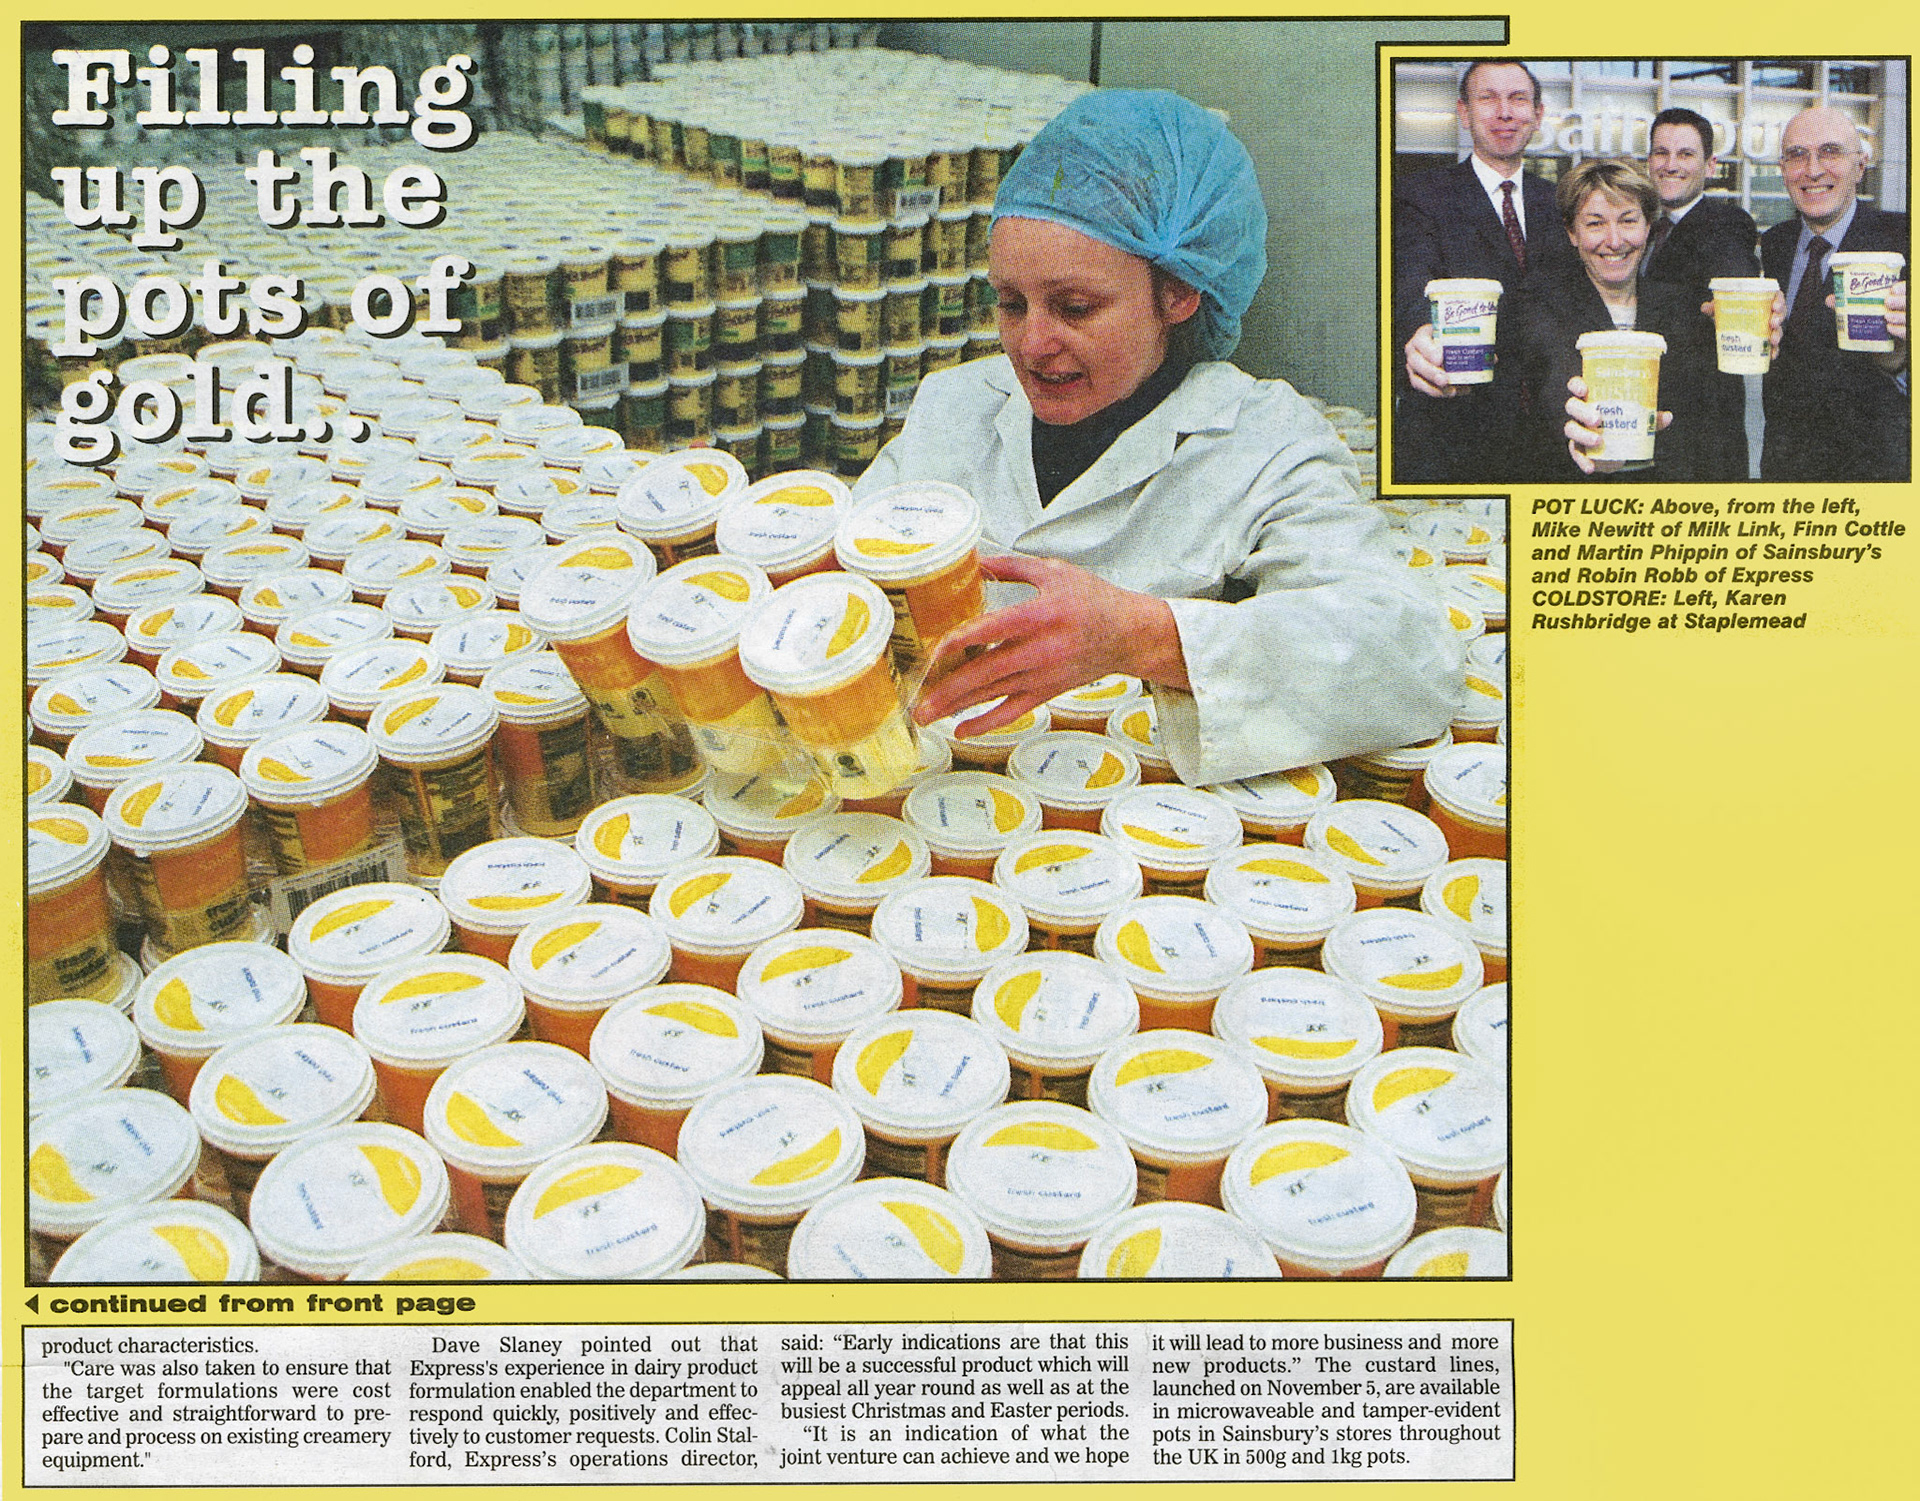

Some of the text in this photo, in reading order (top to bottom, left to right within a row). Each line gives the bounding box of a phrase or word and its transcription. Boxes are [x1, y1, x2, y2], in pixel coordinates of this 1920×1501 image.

[51, 44, 475, 150] Filling
[51, 147, 445, 249] up the
[52, 257, 307, 358] pots
[351, 254, 475, 337] of
[52, 362, 371, 464] gold..
[1597, 418, 1638, 430] ustard
[1532, 498, 1859, 517] POT LUCK: Above, from the left,
[1532, 521, 1905, 539] Mike Newitt of Milk Link, Finn Cottle
[1532, 544, 1881, 564] and Martin Phippin of Sainsbury’s
[1532, 567, 1813, 586] and Robin Robb of Express
[1533, 590, 1786, 609] COLDSTORE: Left, Karen
[1532, 613, 1807, 633] Rushbridge at Staplemead
[50, 1294, 475, 1315] continued from front page
[42, 1337, 258, 1358] product characteristics.
[433, 1336, 758, 1356] Dave Slaney pointed out that
[782, 1334, 822, 1350] said:
[902, 1334, 1000, 1349] indications
[1010, 1338, 1039, 1349] are
[1050, 1333, 1086, 1349] that
[1096, 1333, 1128, 1349] this
[1153, 1334, 1498, 1350] it will lead to more business and more
[121, 1364, 155, 1376] was
[163, 1360, 198, 1376] also
[206, 1360, 255, 1375] taken
[263, 1361, 279, 1375] to
[286, 1363, 348, 1375] ensure
[356, 1359, 391, 1375] that
[505, 1359, 604, 1379] experience
[612, 1359, 628, 1375] in
[635, 1359, 681, 1378] dairy
[688, 1359, 758, 1378] product
[781, 1356, 1128, 1376] will be a successful product which will
[1153, 1362, 1190, 1373] new
[1315, 1357, 1351, 1372] The
[1366, 1356, 1436, 1372] custard
[1450, 1356, 1499, 1375] lines,
[43, 1382, 391, 1403] the target formulations were cost
[410, 1382, 757, 1401] formulation enabled the department to
[781, 1379, 1129, 1400] appeal all year round as well as at the
[1153, 1379, 1499, 1398] launched on November 5, are available
[43, 1405, 390, 1425] effective and straightforward to pre-
[410, 1404, 757, 1425] respond quickly, positively and effec-
